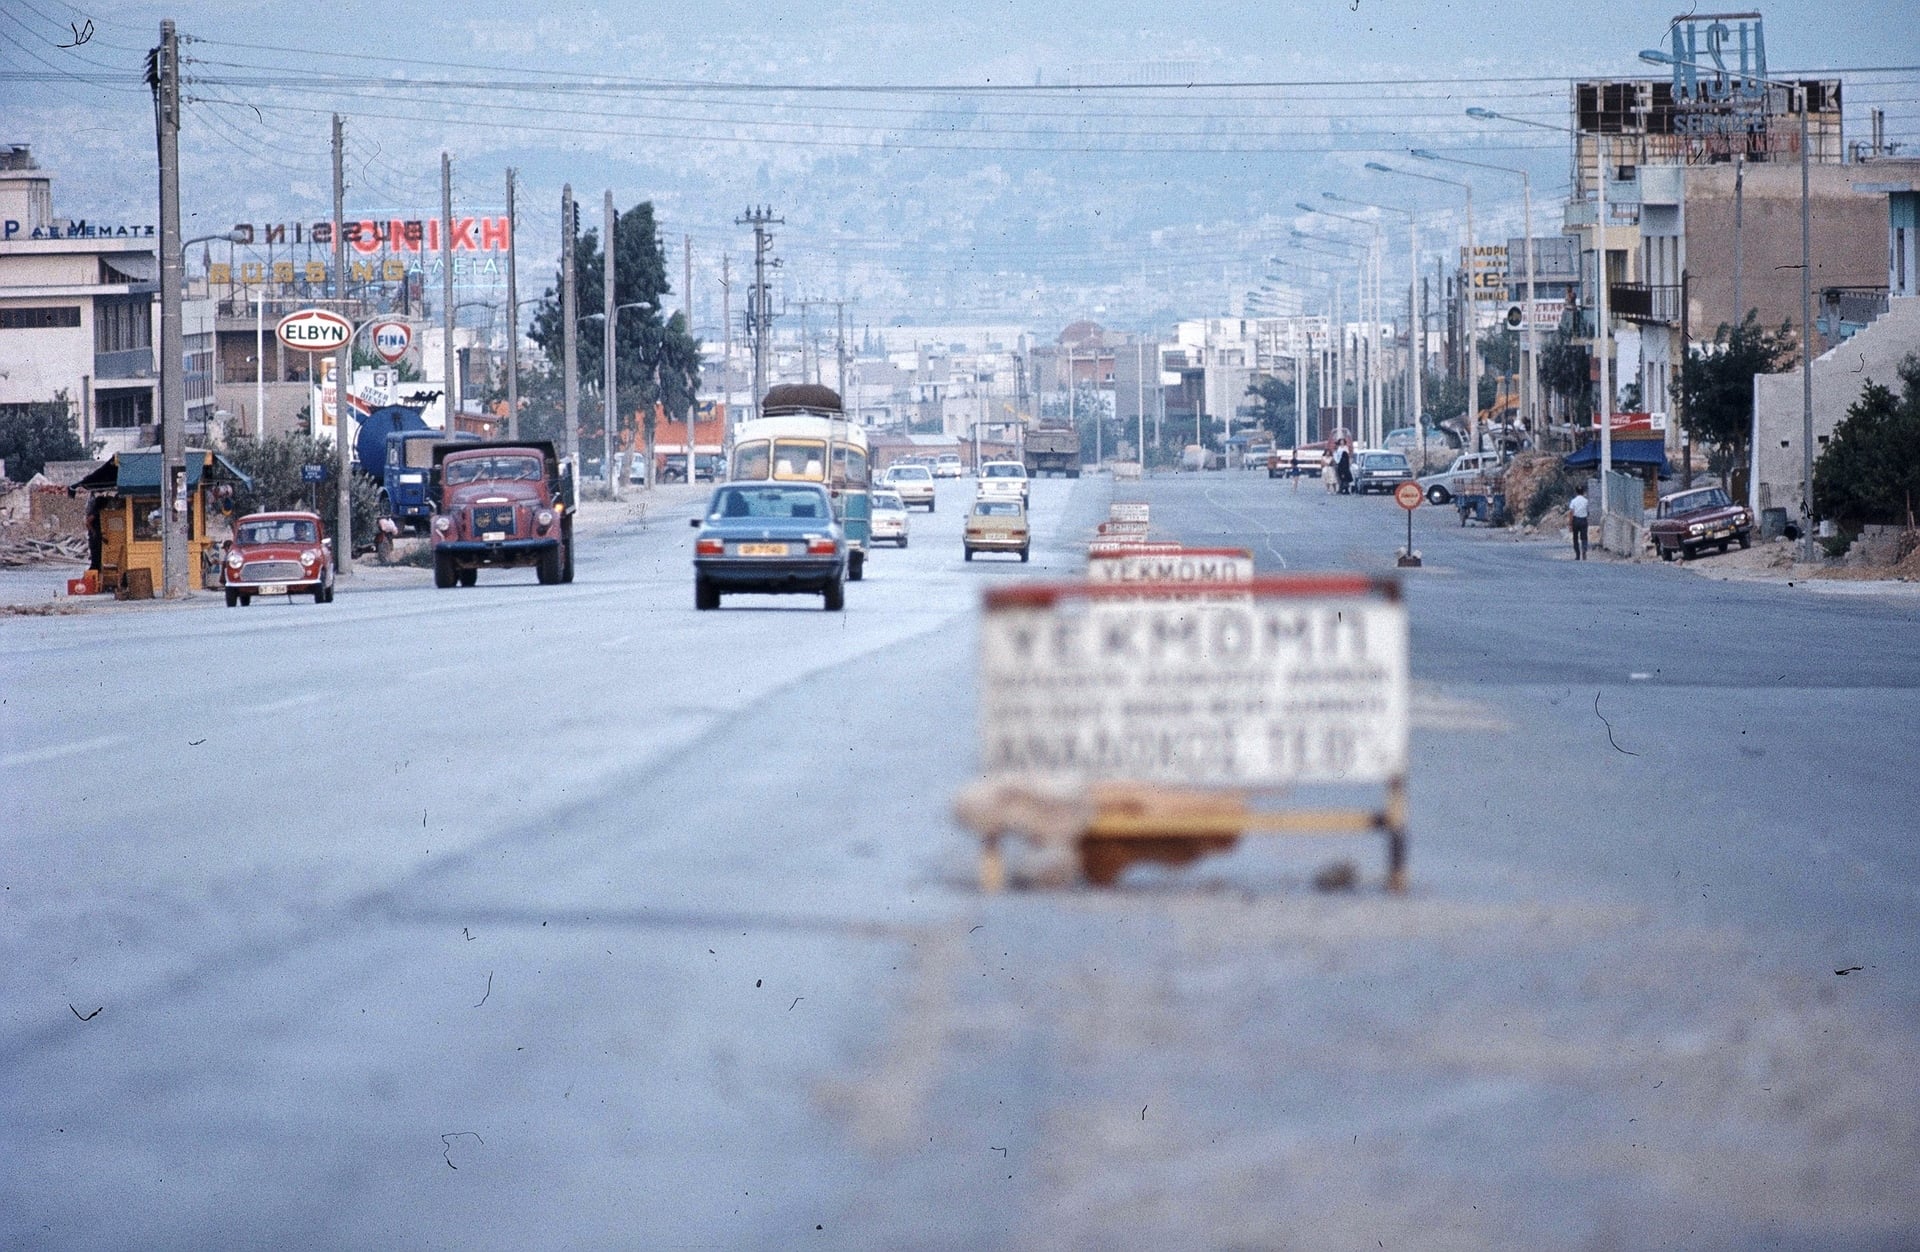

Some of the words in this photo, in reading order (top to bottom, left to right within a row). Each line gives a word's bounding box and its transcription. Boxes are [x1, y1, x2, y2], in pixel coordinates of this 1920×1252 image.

[1672, 22, 1766, 101] NSU
[209, 261, 404, 284] BUSSNG
[286, 325, 343, 341] ELBYN
[377, 334, 406, 347] FINA
